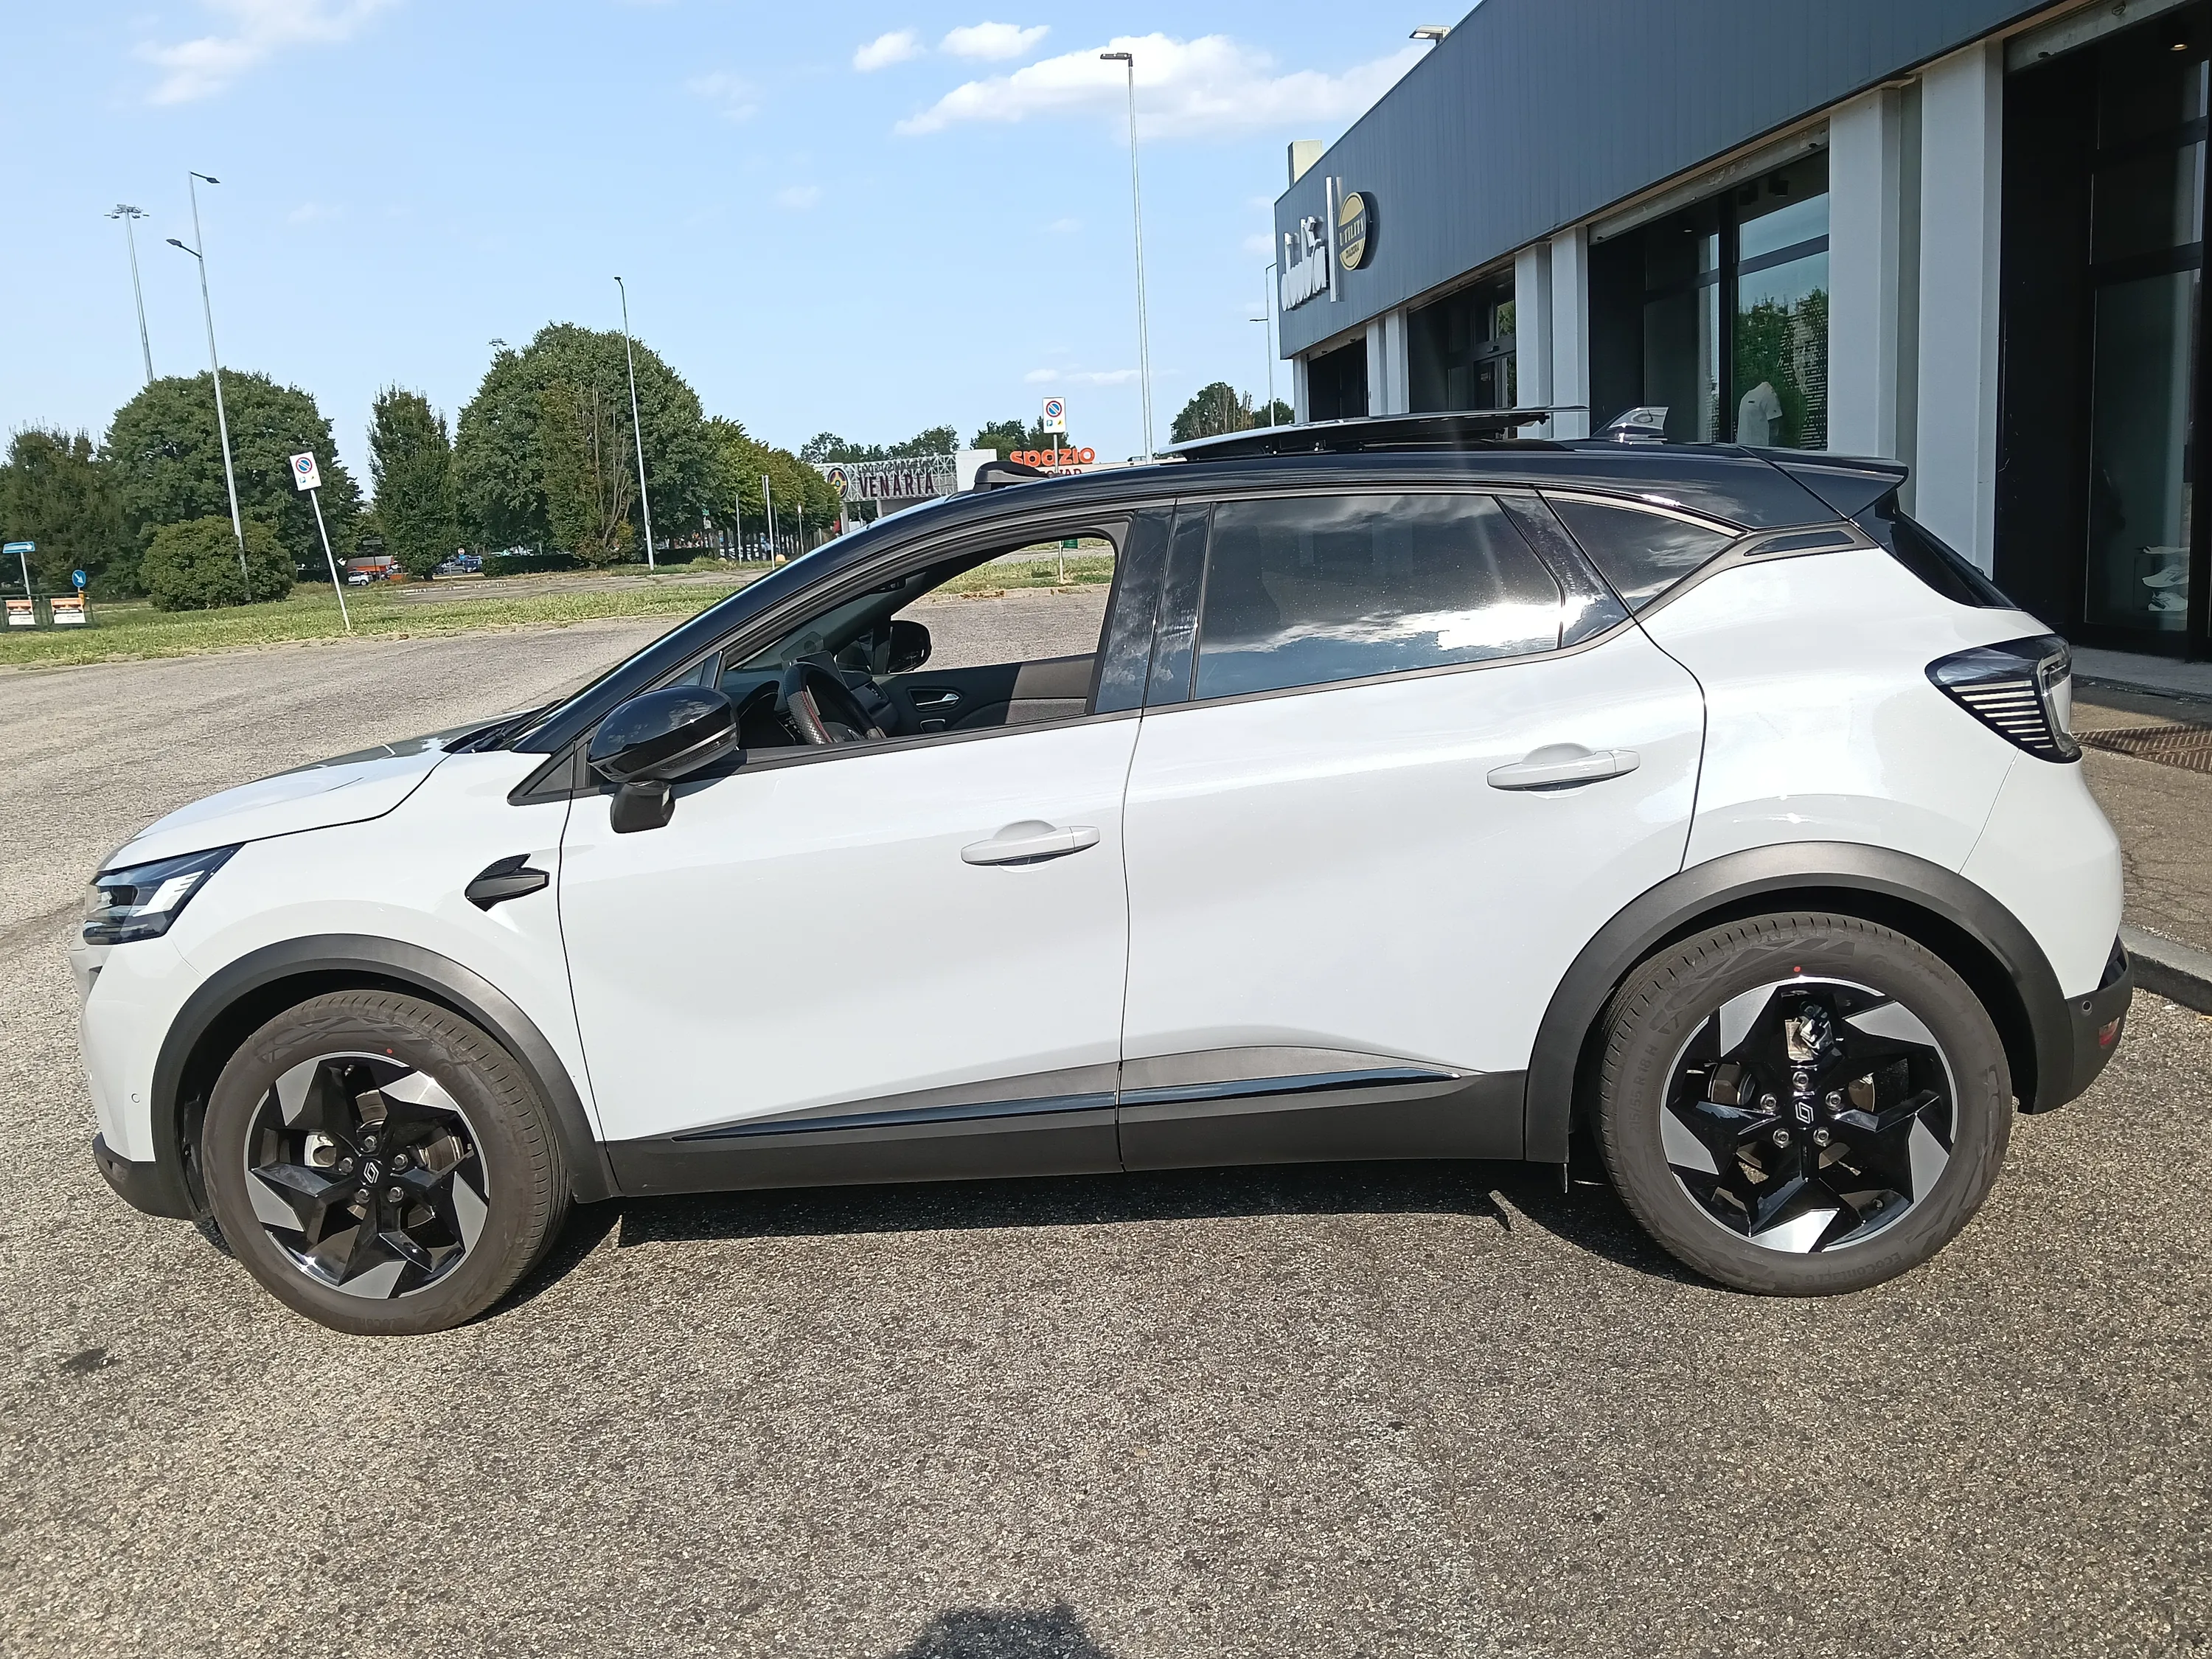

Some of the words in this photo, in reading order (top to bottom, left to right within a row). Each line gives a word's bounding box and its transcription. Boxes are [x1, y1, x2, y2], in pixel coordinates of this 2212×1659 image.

[1009, 447, 1095, 467] spazio
[858, 471, 935, 498] VENARIA
[1818, 1252, 1903, 1282] EcoContact
